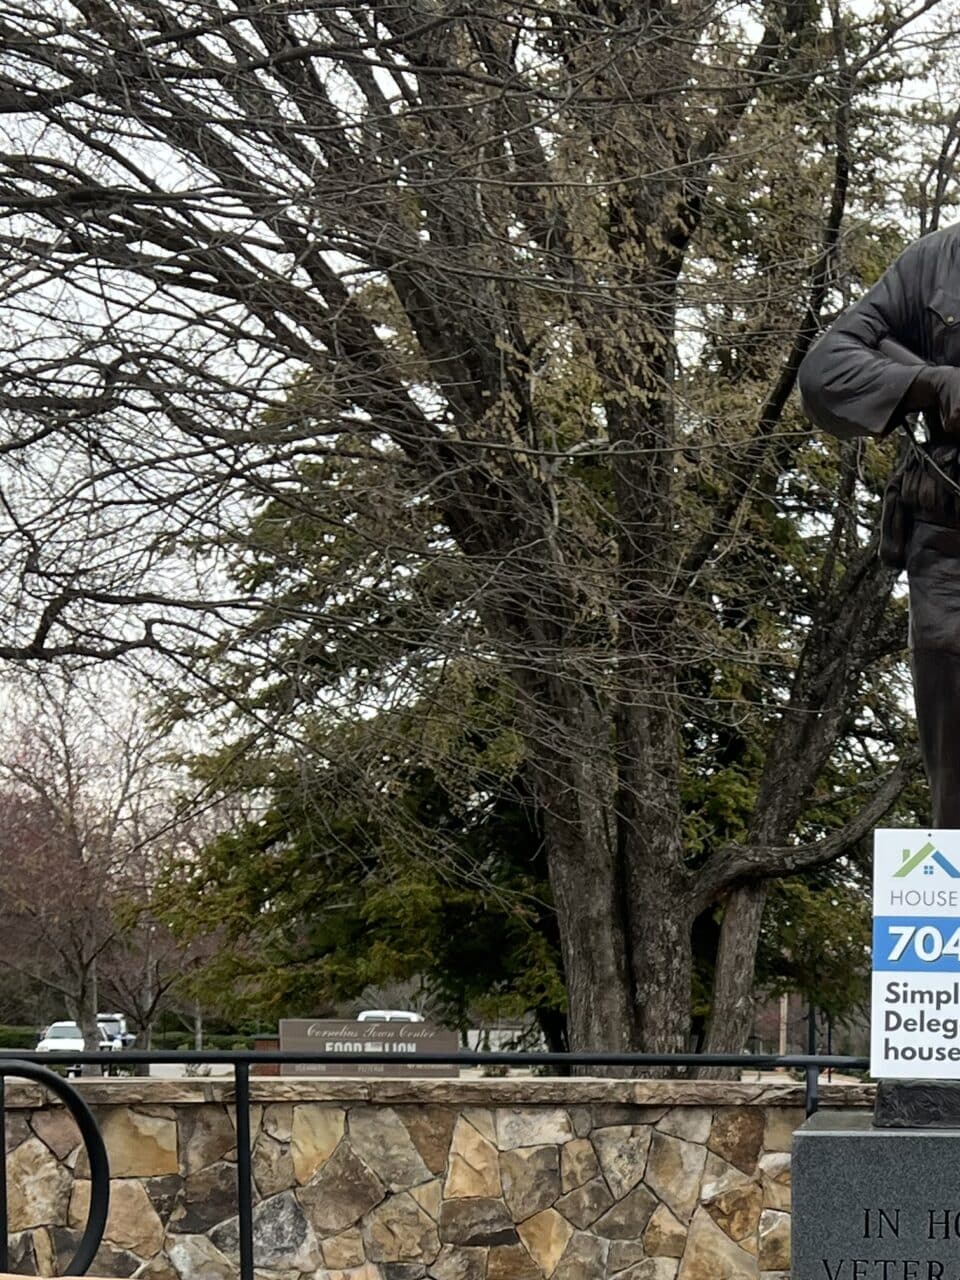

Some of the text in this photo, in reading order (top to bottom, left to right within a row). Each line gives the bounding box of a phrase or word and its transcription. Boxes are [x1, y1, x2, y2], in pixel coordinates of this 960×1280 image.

[890, 890, 958, 907] HOUSE
[306, 1023, 437, 1039] Cornelius Town Center
[862, 1208, 901, 1239] IN
